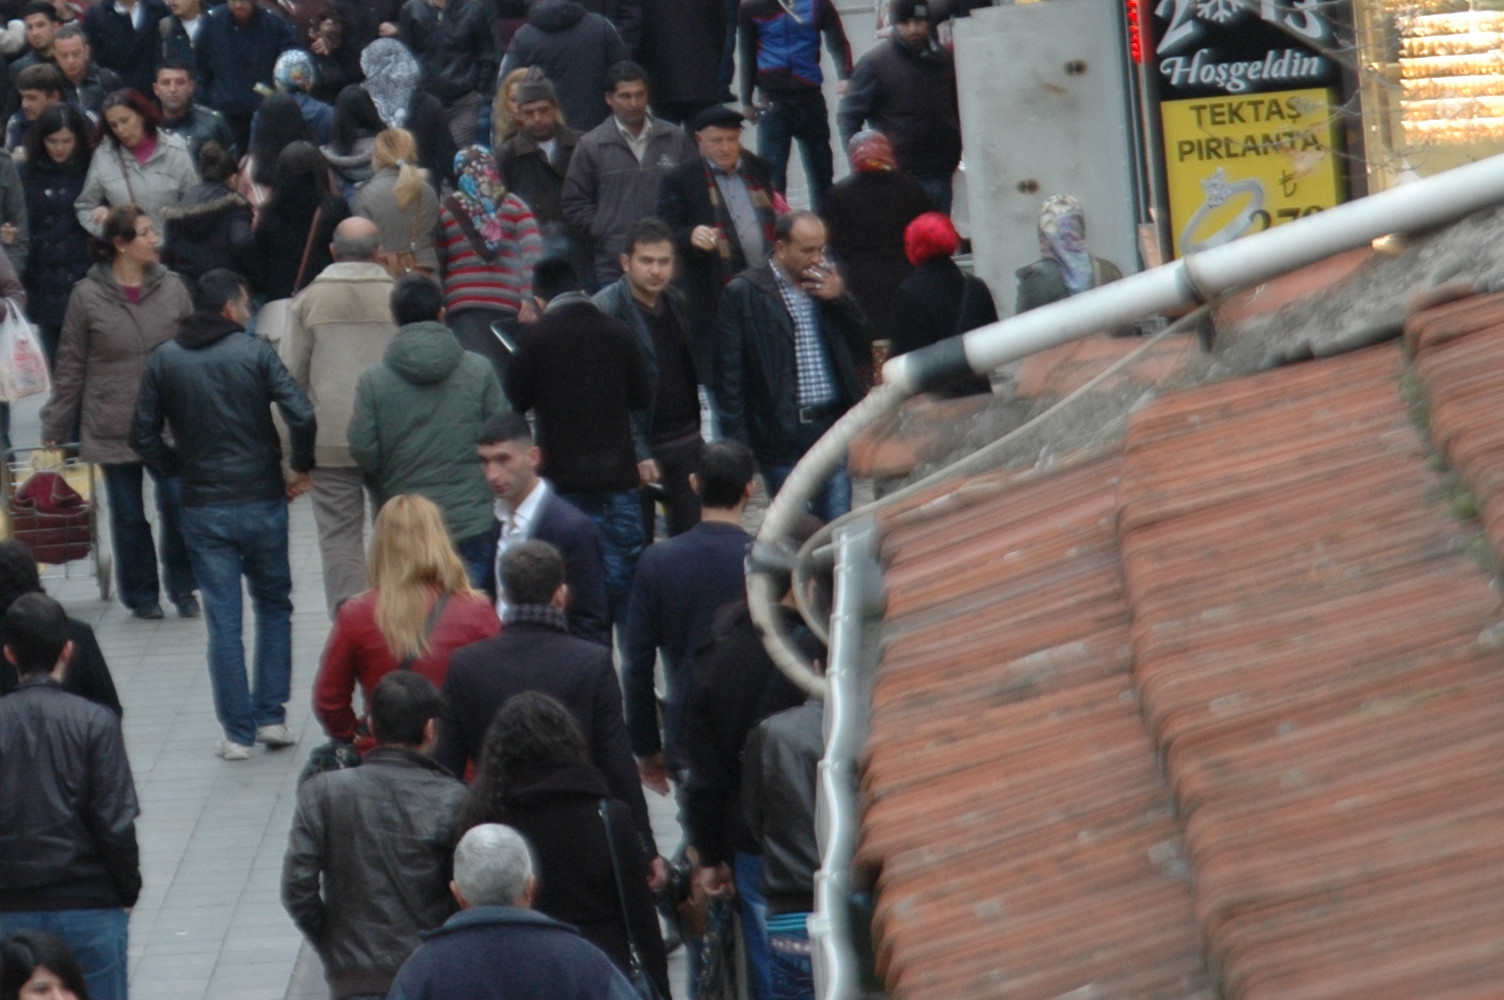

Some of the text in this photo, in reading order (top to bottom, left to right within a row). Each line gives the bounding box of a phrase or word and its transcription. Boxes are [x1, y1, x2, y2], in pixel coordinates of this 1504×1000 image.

[1160, 48, 1319, 93] Hoşgeldin
[1189, 96, 1303, 127] TEKTAŞ
[1177, 131, 1323, 163] PIRLANTA
